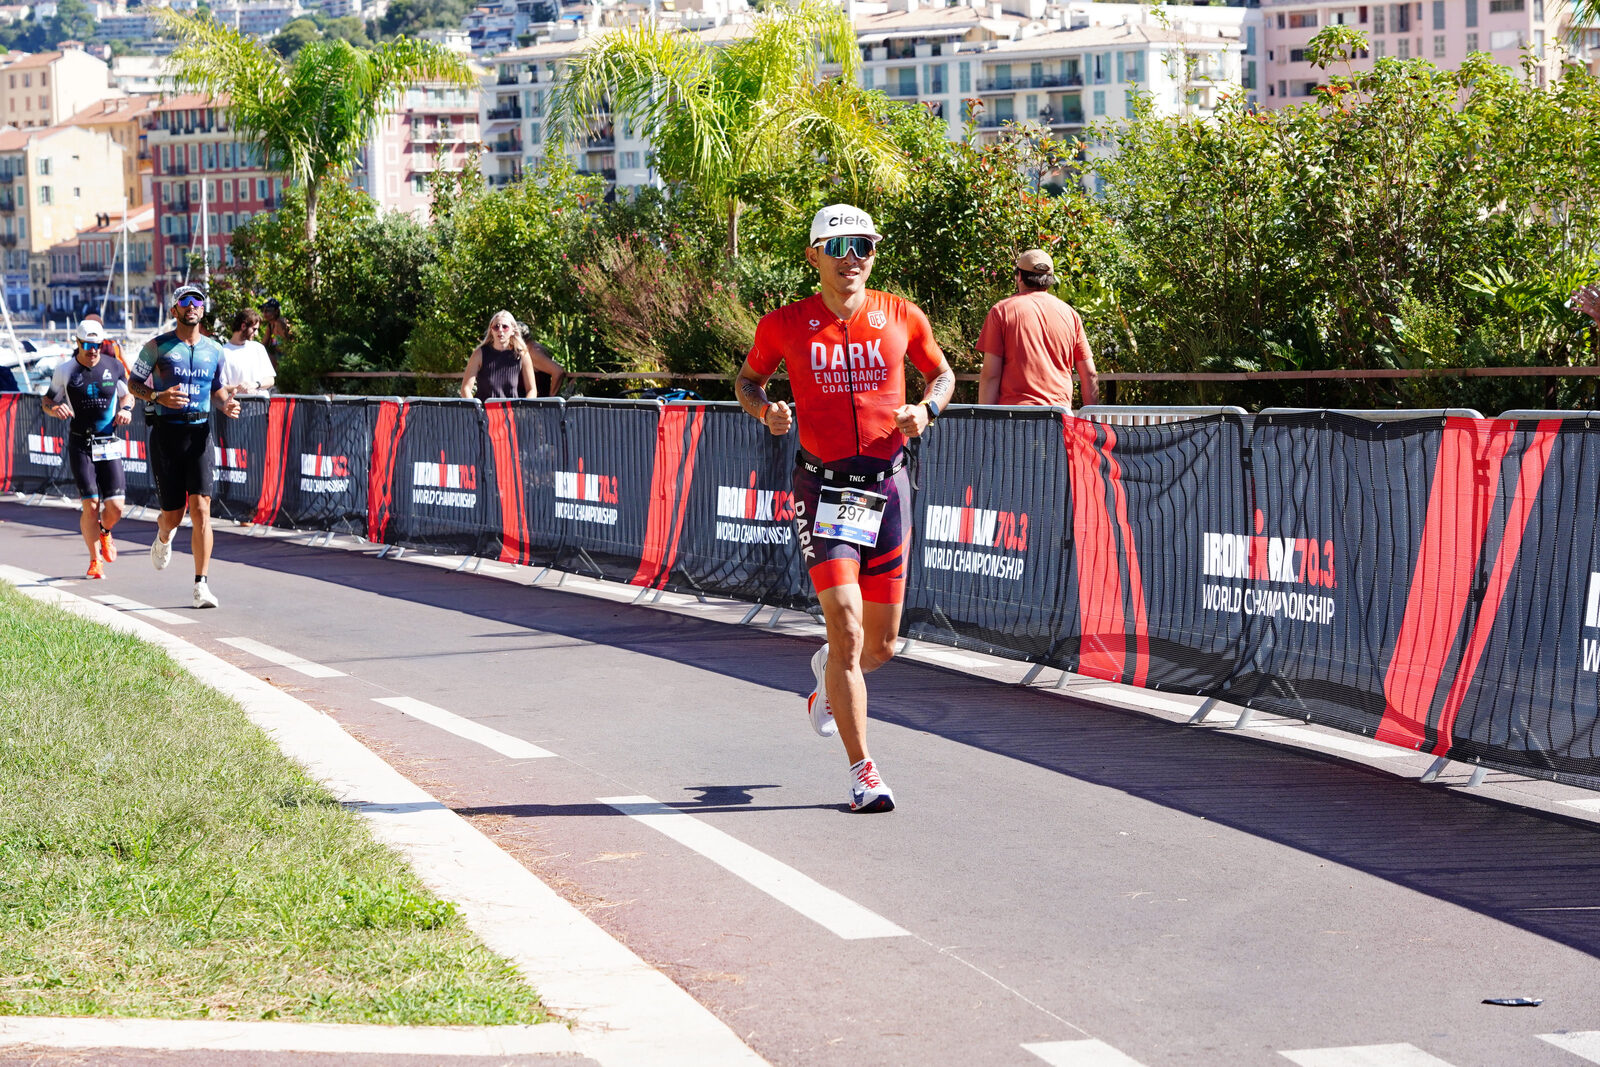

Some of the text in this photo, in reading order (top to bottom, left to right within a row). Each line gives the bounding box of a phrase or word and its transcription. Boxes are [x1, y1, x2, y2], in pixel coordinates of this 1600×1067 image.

[811, 338, 886, 371] DARK
[174, 366, 209, 377] RAMIN
[814, 368, 888, 384] ENDURANCE
[822, 382, 878, 393] COACHING
[804, 462, 818, 473] TNLC
[413, 489, 435, 504] WORD
[837, 505, 865, 522] 297
[716, 521, 740, 542] WORLD
[795, 500, 816, 560] DARK
[993, 511, 1028, 552] 70.3
[924, 546, 1024, 580] WORLD CHAMPIONSHIP
[1294, 537, 1335, 589] 70.3
[1202, 583, 1335, 625] WORLD CHAMPIONSHIP
